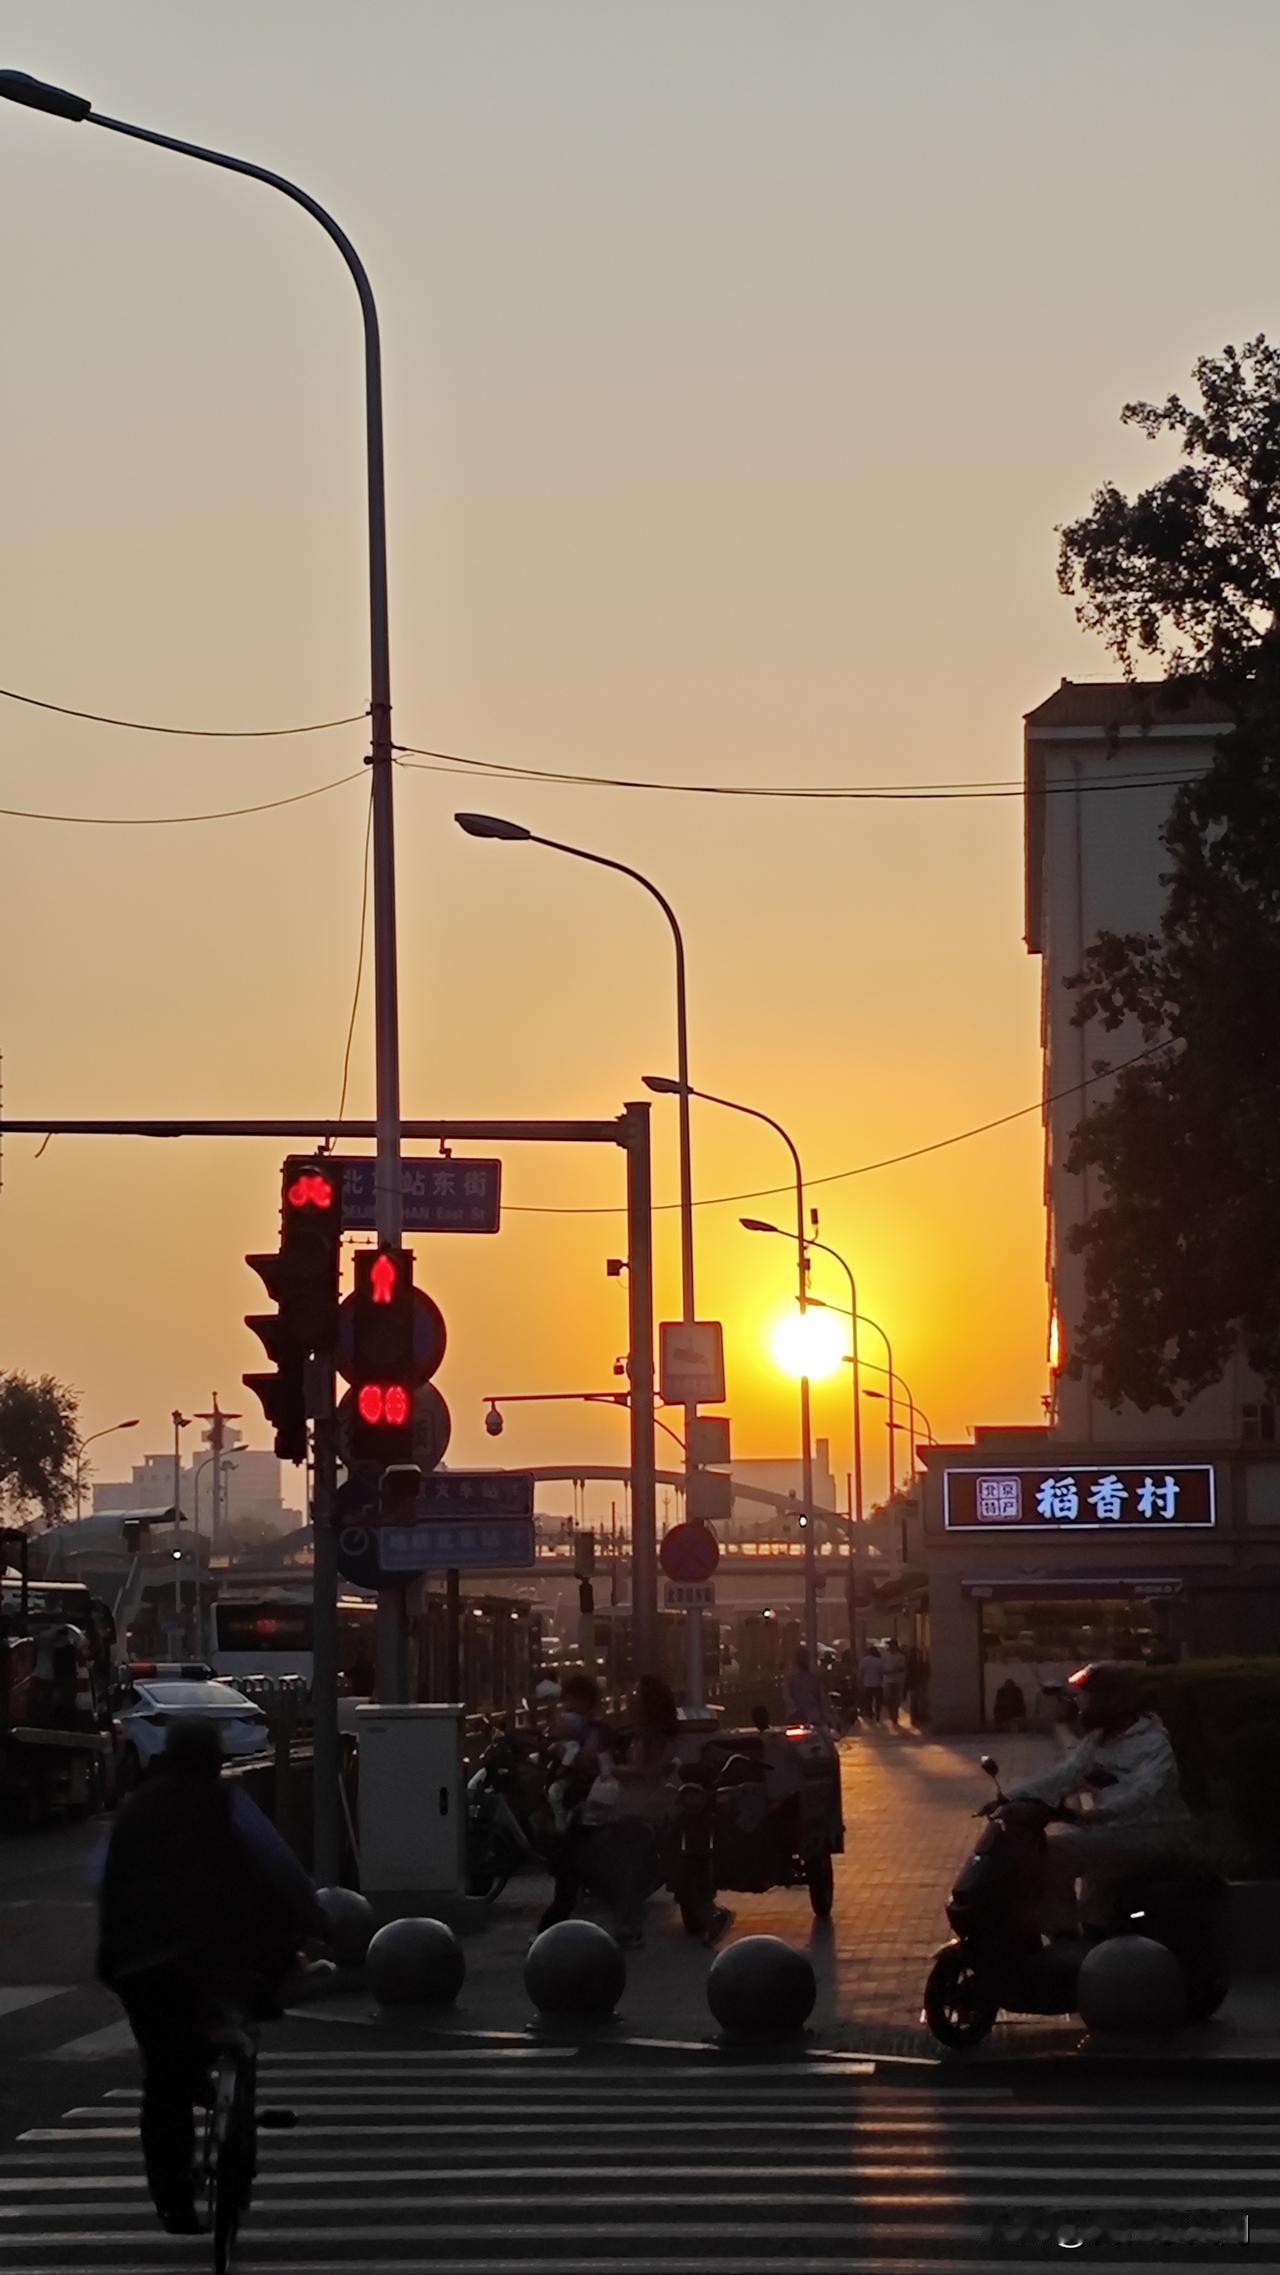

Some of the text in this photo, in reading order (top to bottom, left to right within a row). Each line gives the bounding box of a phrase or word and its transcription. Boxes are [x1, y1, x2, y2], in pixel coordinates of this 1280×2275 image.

[343, 1168, 488, 1197] 北站东街
[981, 1481, 1017, 1498] 北京
[1035, 1474, 1180, 1521] 稻香村
[981, 1500, 1017, 1517] 特产
